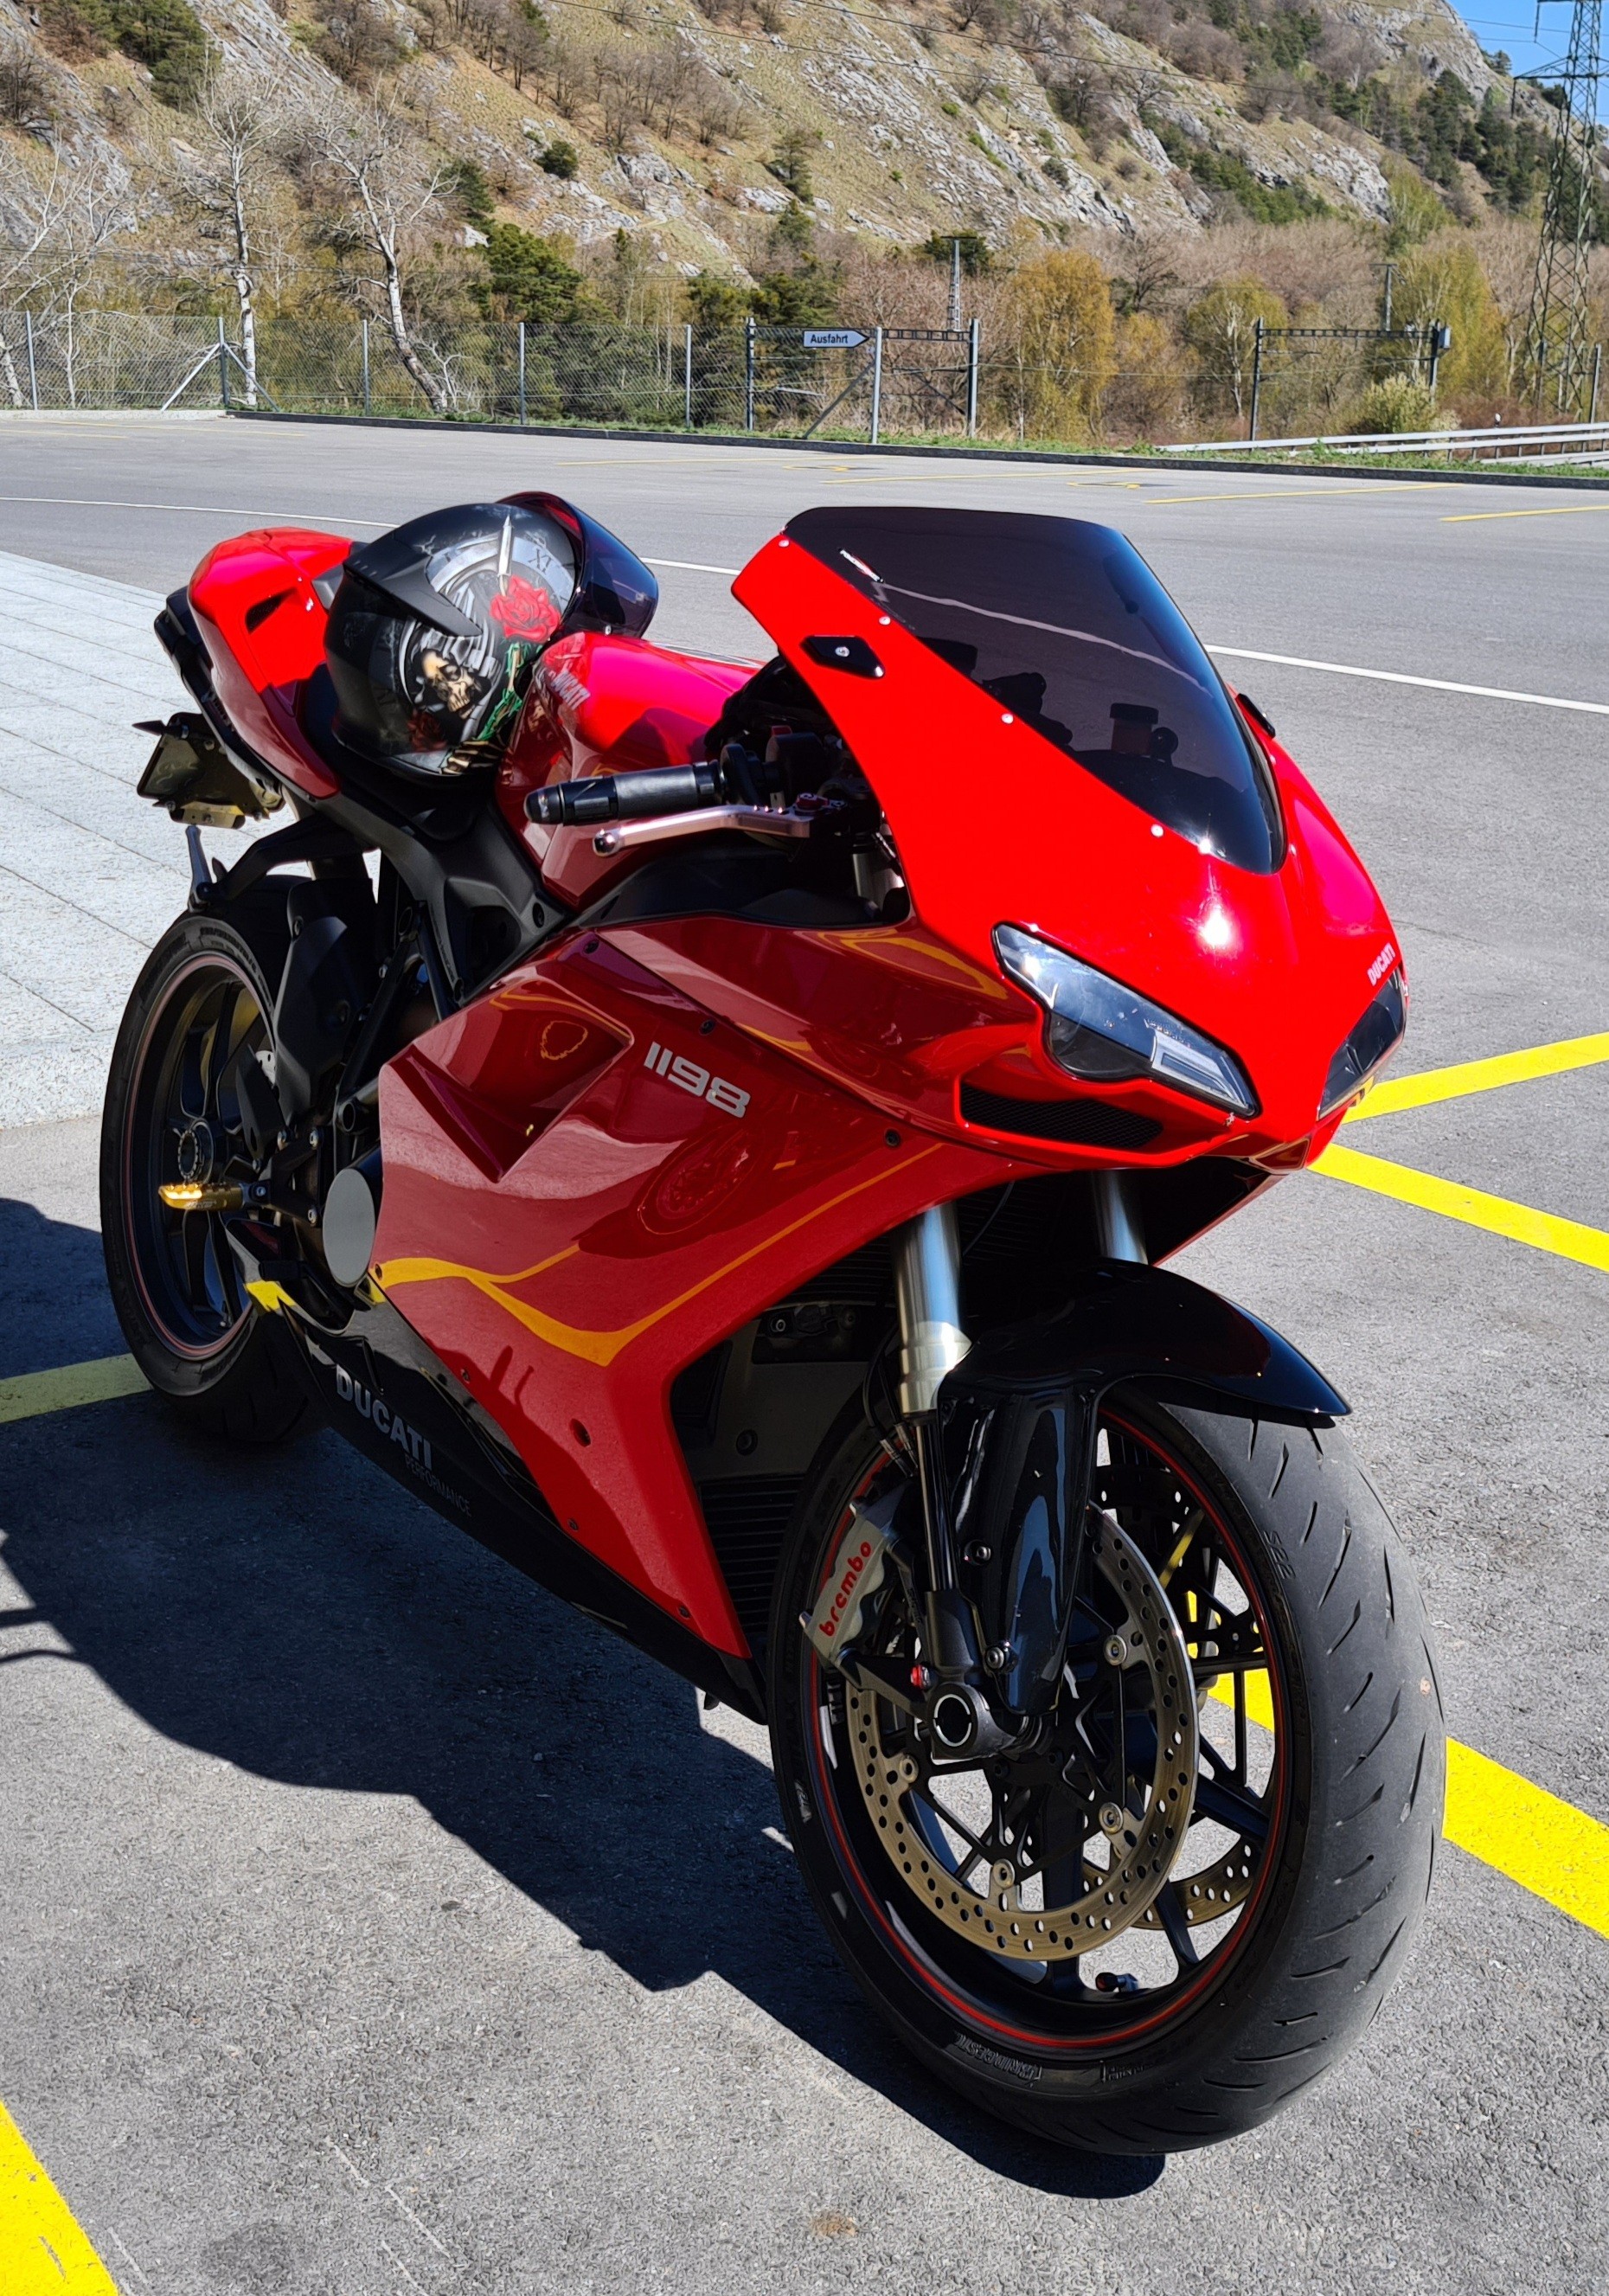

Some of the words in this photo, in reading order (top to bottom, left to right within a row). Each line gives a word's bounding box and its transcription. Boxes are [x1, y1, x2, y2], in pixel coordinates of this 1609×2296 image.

[811, 334, 849, 343] Ausfahrt
[1367, 943, 1395, 986] DUCATI
[644, 1041, 751, 1119] 1198
[336, 1363, 433, 1471] DUCATI
[819, 1541, 872, 1637] brembo
